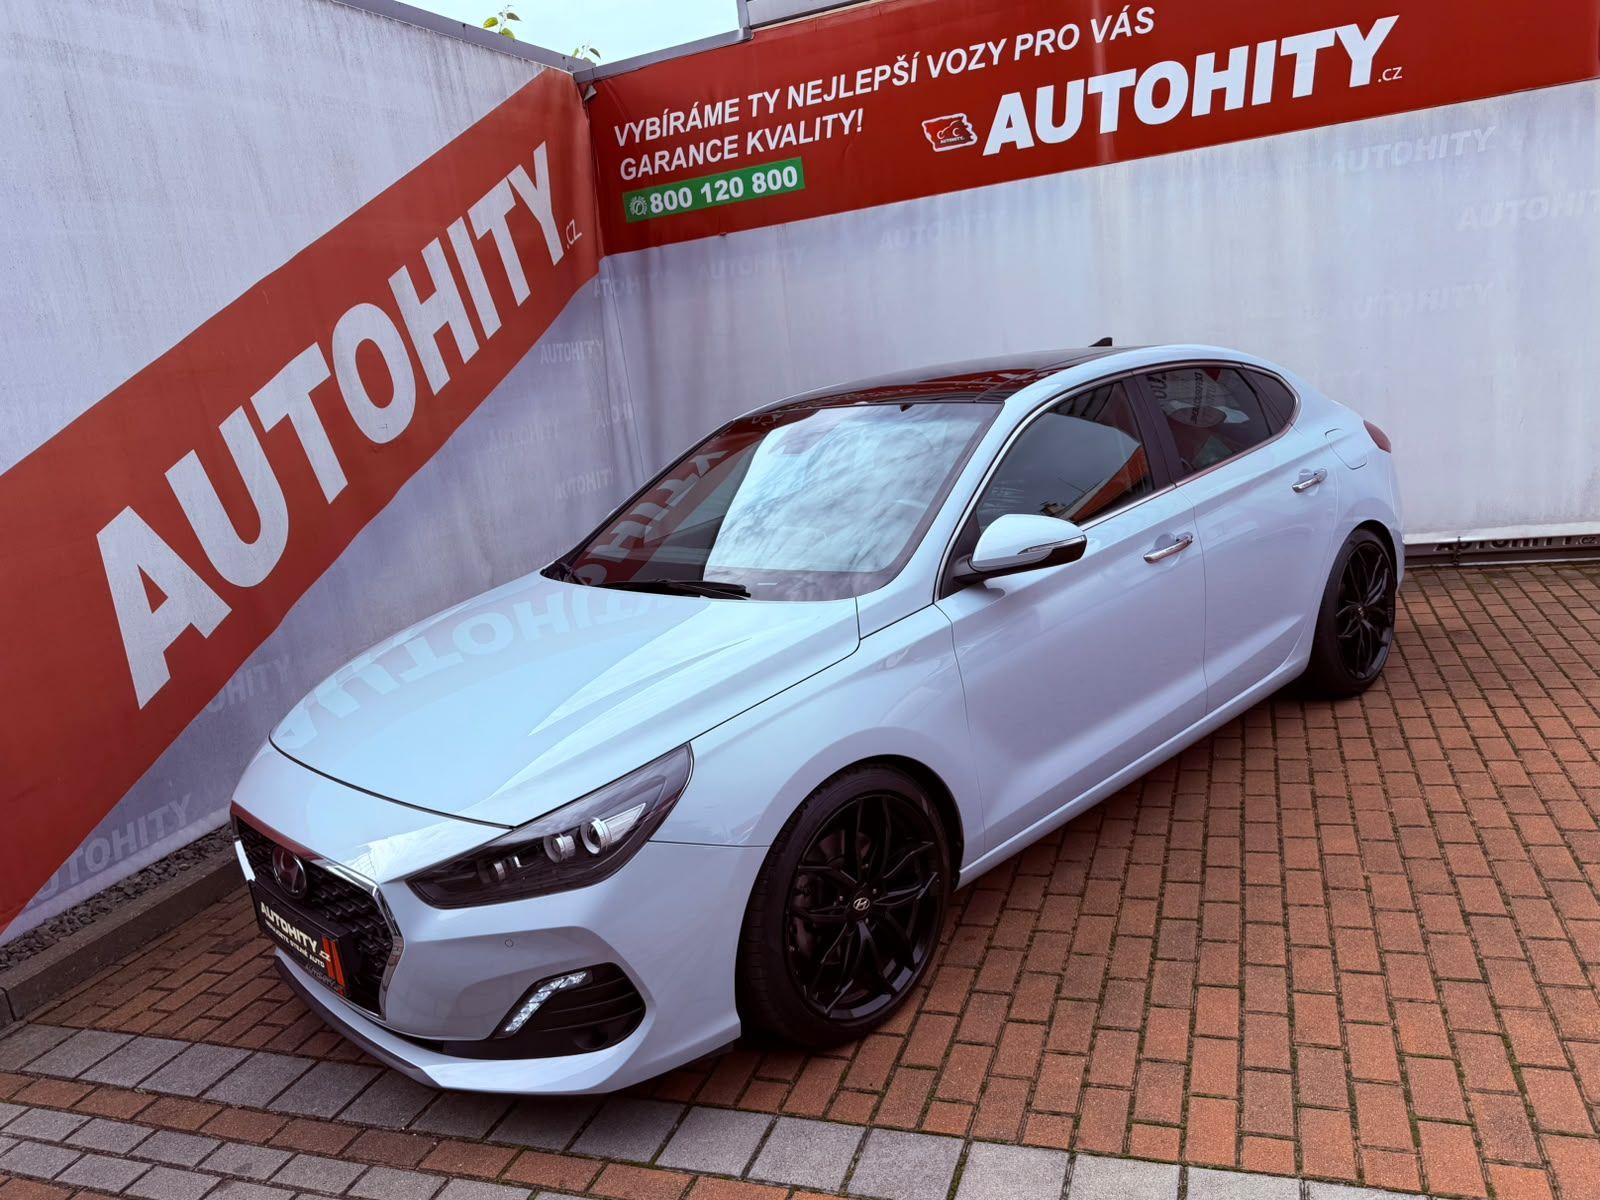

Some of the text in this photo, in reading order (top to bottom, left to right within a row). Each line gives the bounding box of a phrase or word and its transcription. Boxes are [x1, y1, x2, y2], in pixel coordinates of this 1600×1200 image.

[614, 4, 1155, 147] VYBÍRÁME TY NEJLEPŠÍ VOZY PRO VÁS
[982, 15, 1400, 156] AUTOHITY
[620, 107, 864, 181] GARANCE KVALITY!
[1332, 126, 1496, 172] AUTOHITY
[650, 165, 798, 214] 800 120 800
[96, 141, 565, 711] AUTOHITY
[260, 901, 317, 953] AUTOHITY
